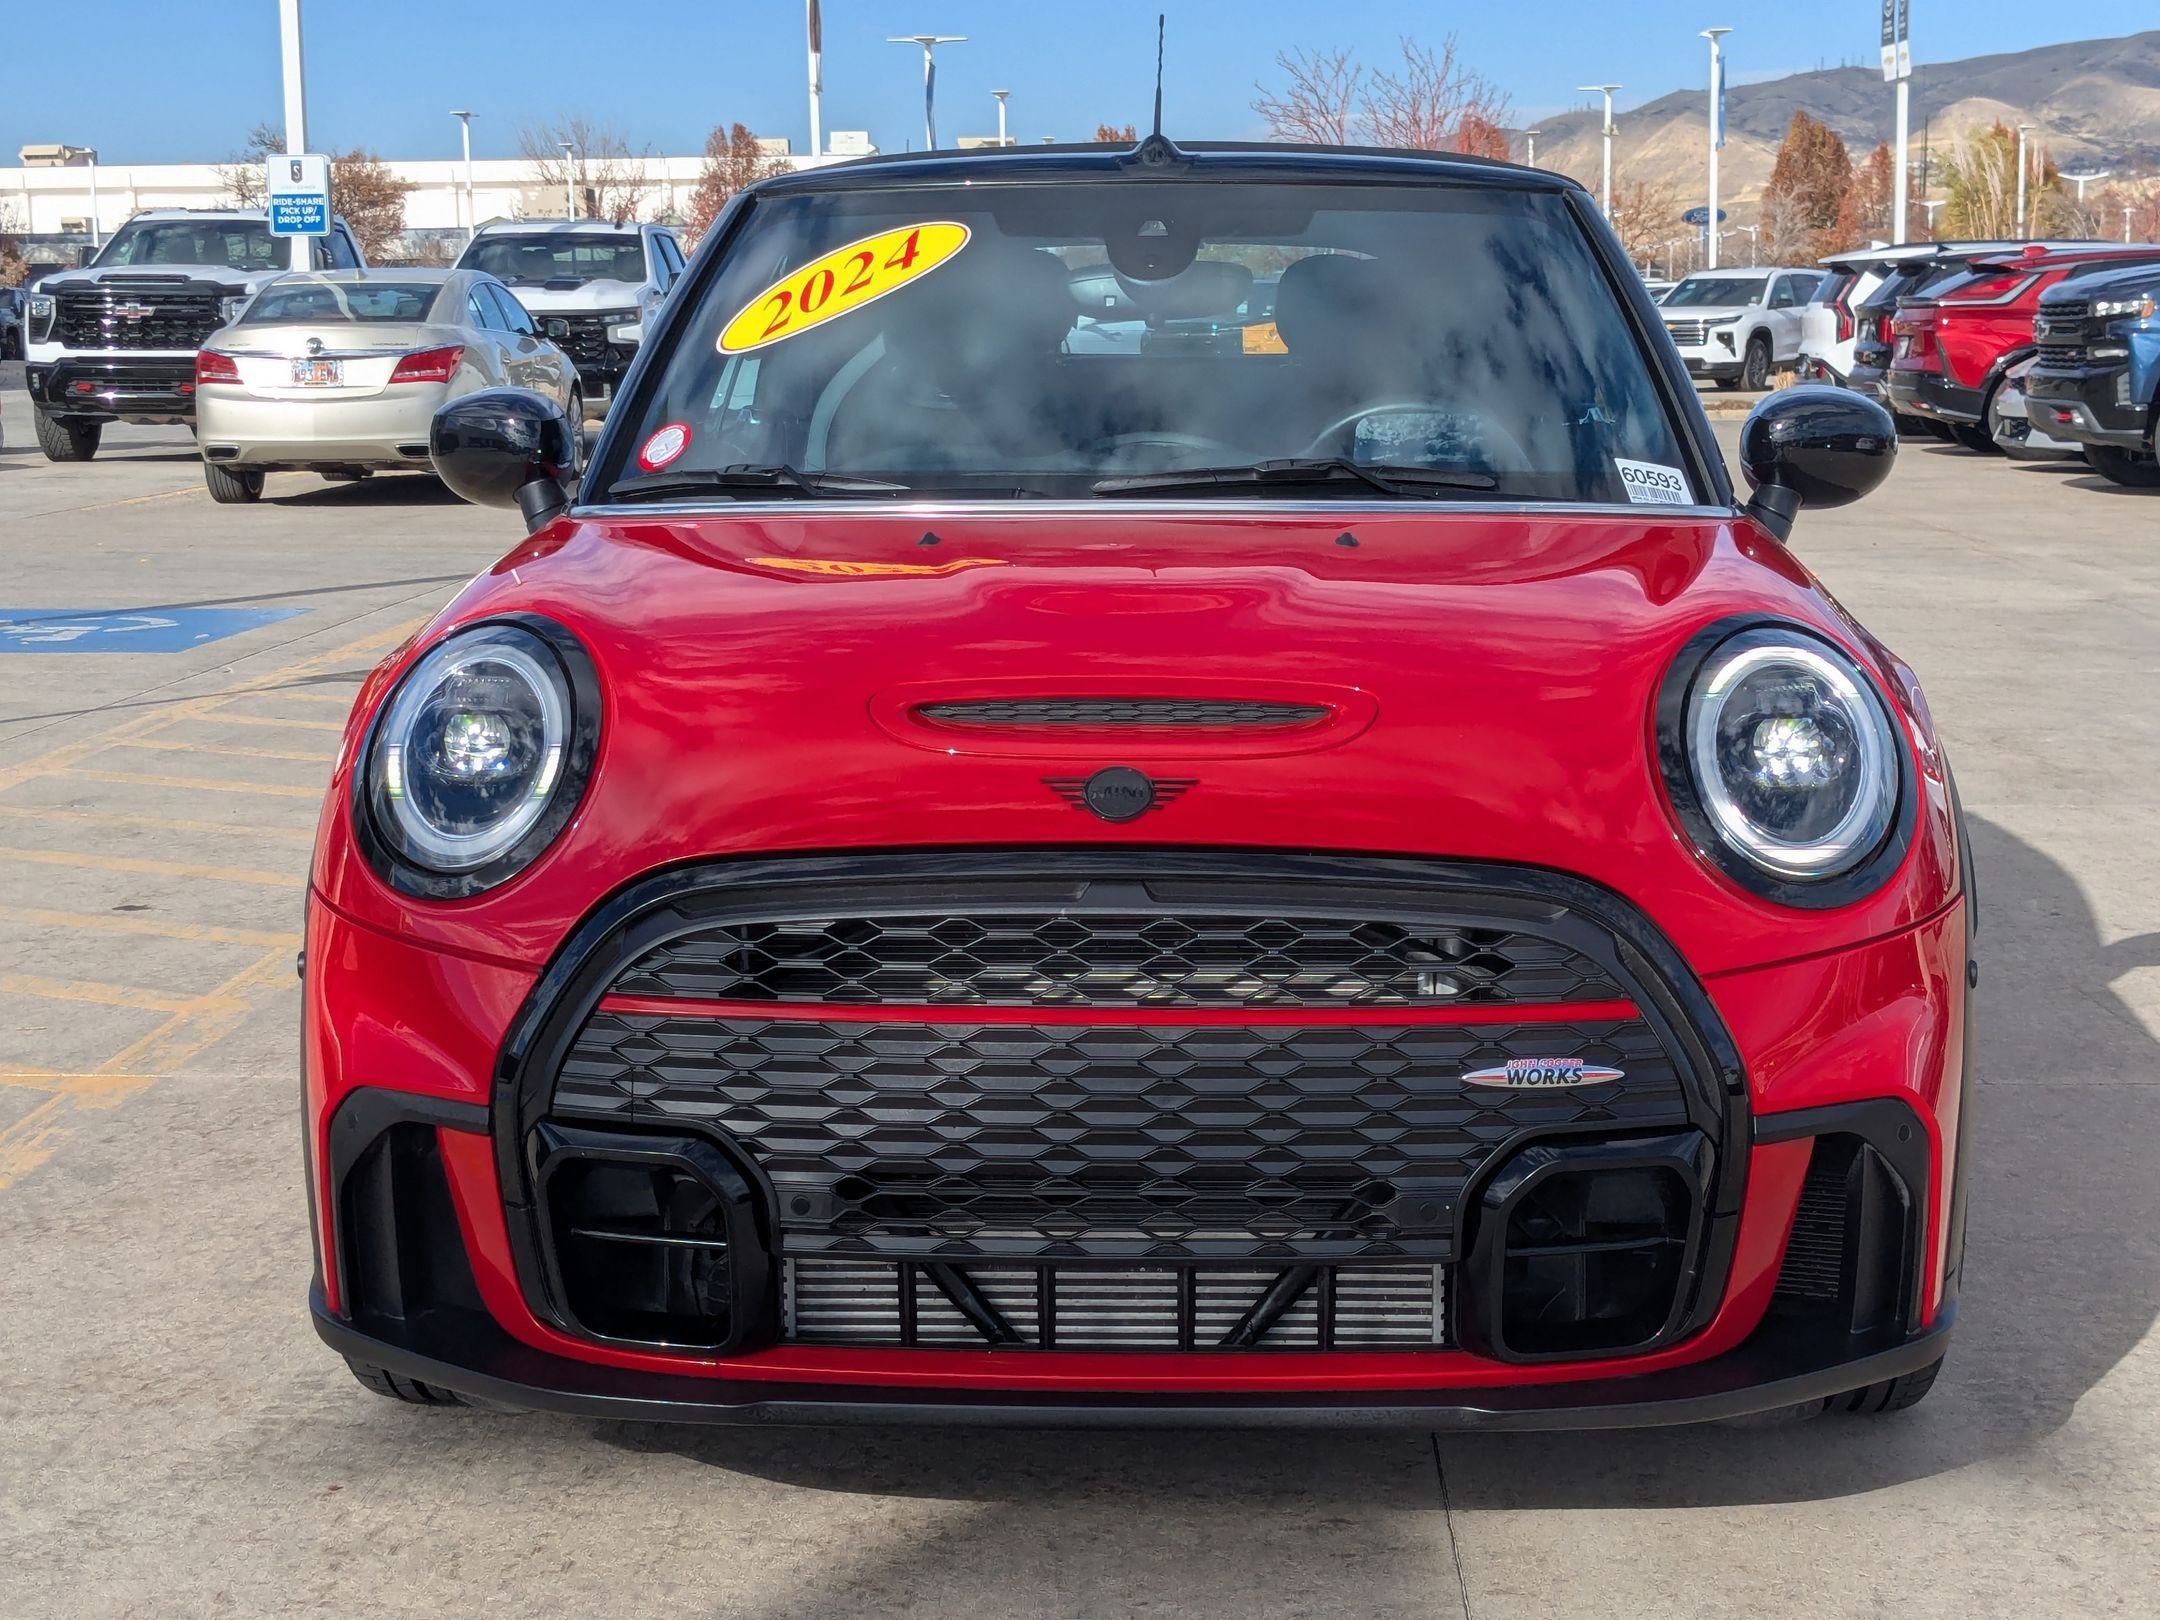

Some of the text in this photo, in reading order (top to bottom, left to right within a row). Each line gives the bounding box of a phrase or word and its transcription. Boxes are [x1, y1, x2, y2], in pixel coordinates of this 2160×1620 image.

[273, 197, 324, 206] RIDE-SHARE
[280, 205, 317, 215] PICK UP/
[278, 215, 321, 224] DROP OFF
[758, 228, 921, 341] 2024
[1621, 466, 1682, 492] 60593
[1505, 1057, 1584, 1070] JOHN COOPER
[1505, 1067, 1584, 1086] WORKS
